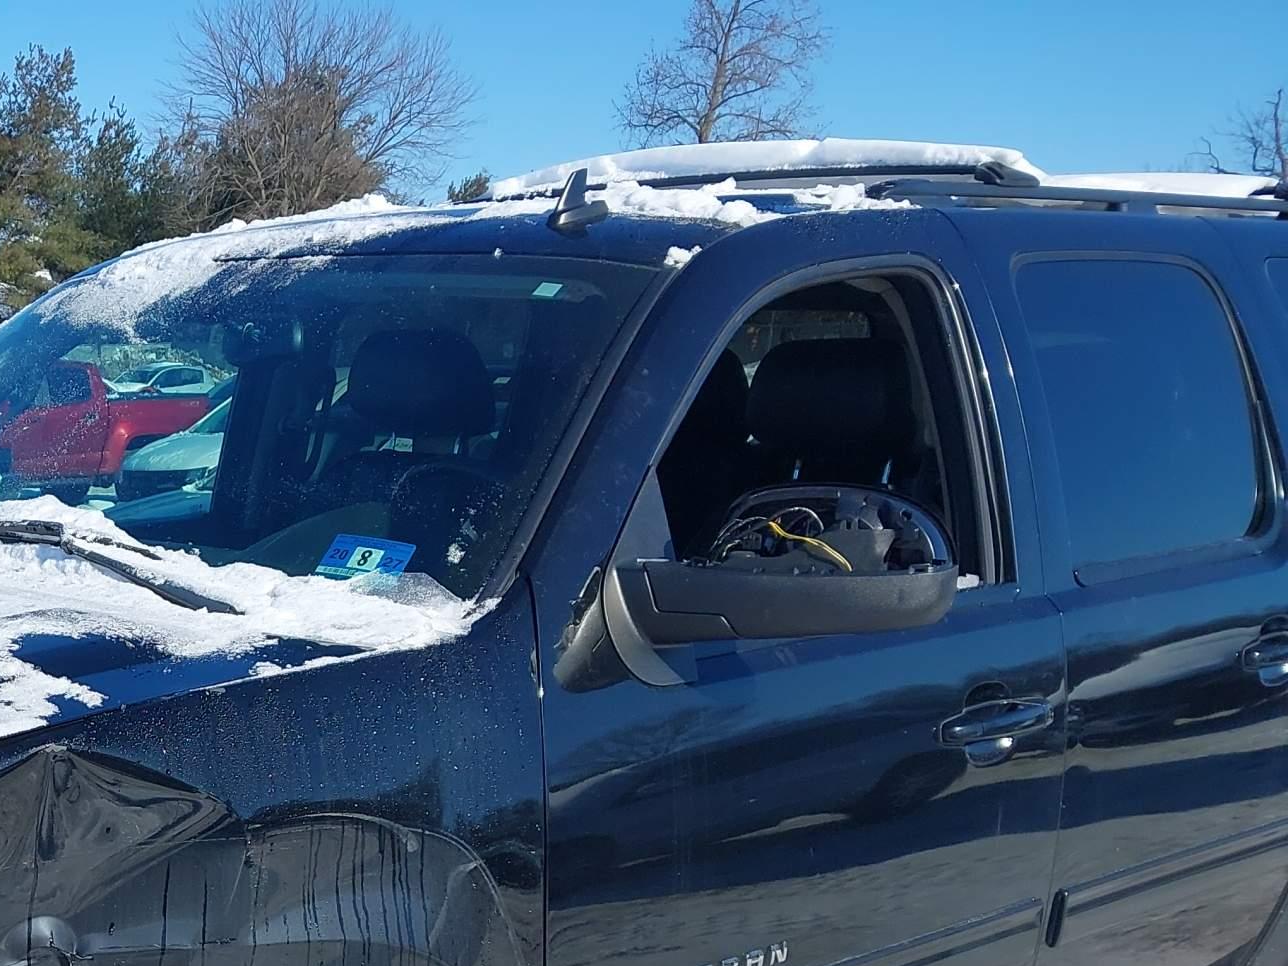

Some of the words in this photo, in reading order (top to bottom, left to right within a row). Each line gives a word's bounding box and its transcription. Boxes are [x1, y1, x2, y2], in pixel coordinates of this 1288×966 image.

[329, 548, 350, 560] 20
[357, 549, 373, 567] 8
[381, 557, 402, 569] 27
